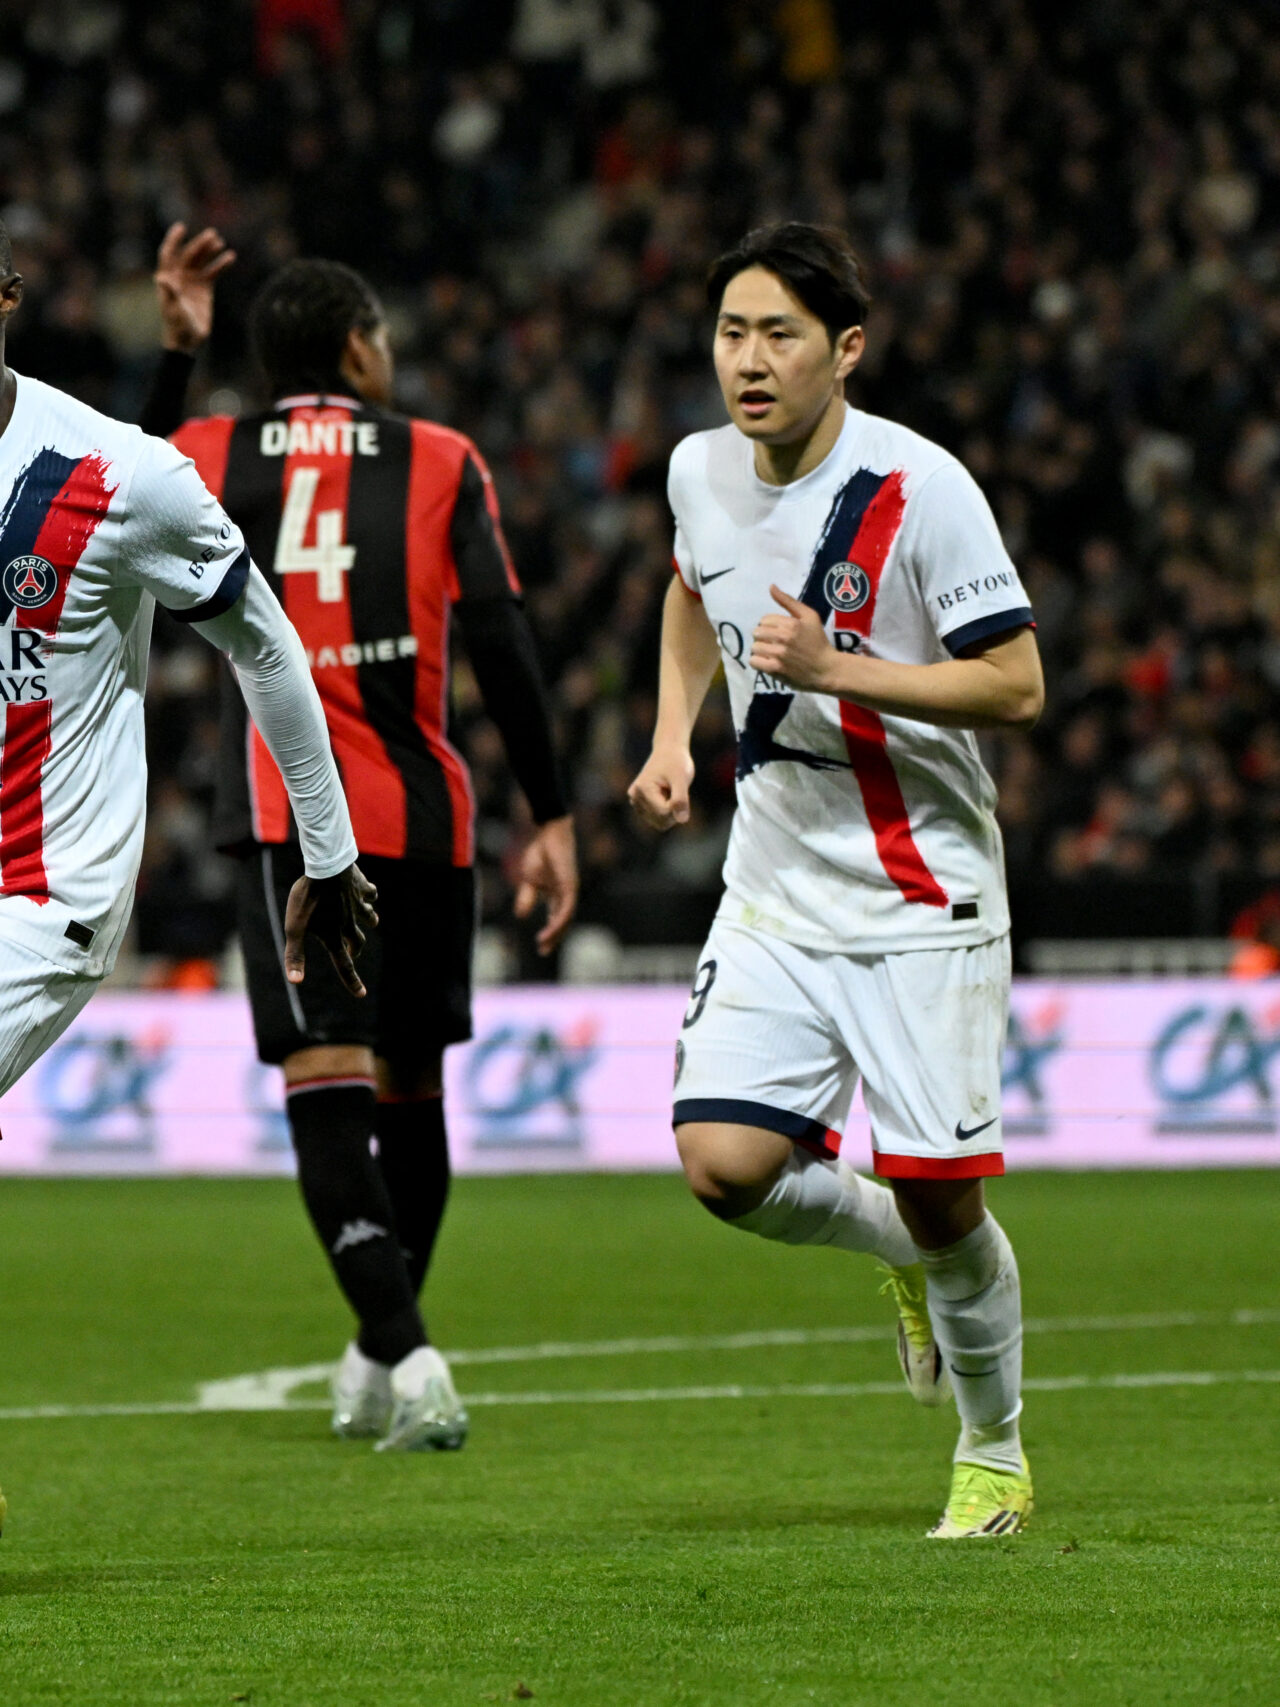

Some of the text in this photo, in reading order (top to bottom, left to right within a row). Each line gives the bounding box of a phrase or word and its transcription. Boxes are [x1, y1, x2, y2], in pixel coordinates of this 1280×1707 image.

[260, 421, 380, 457] DANTE
[273, 467, 357, 603] 4
[12, 558, 49, 572] PARIS
[832, 565, 862, 578] PARIS
